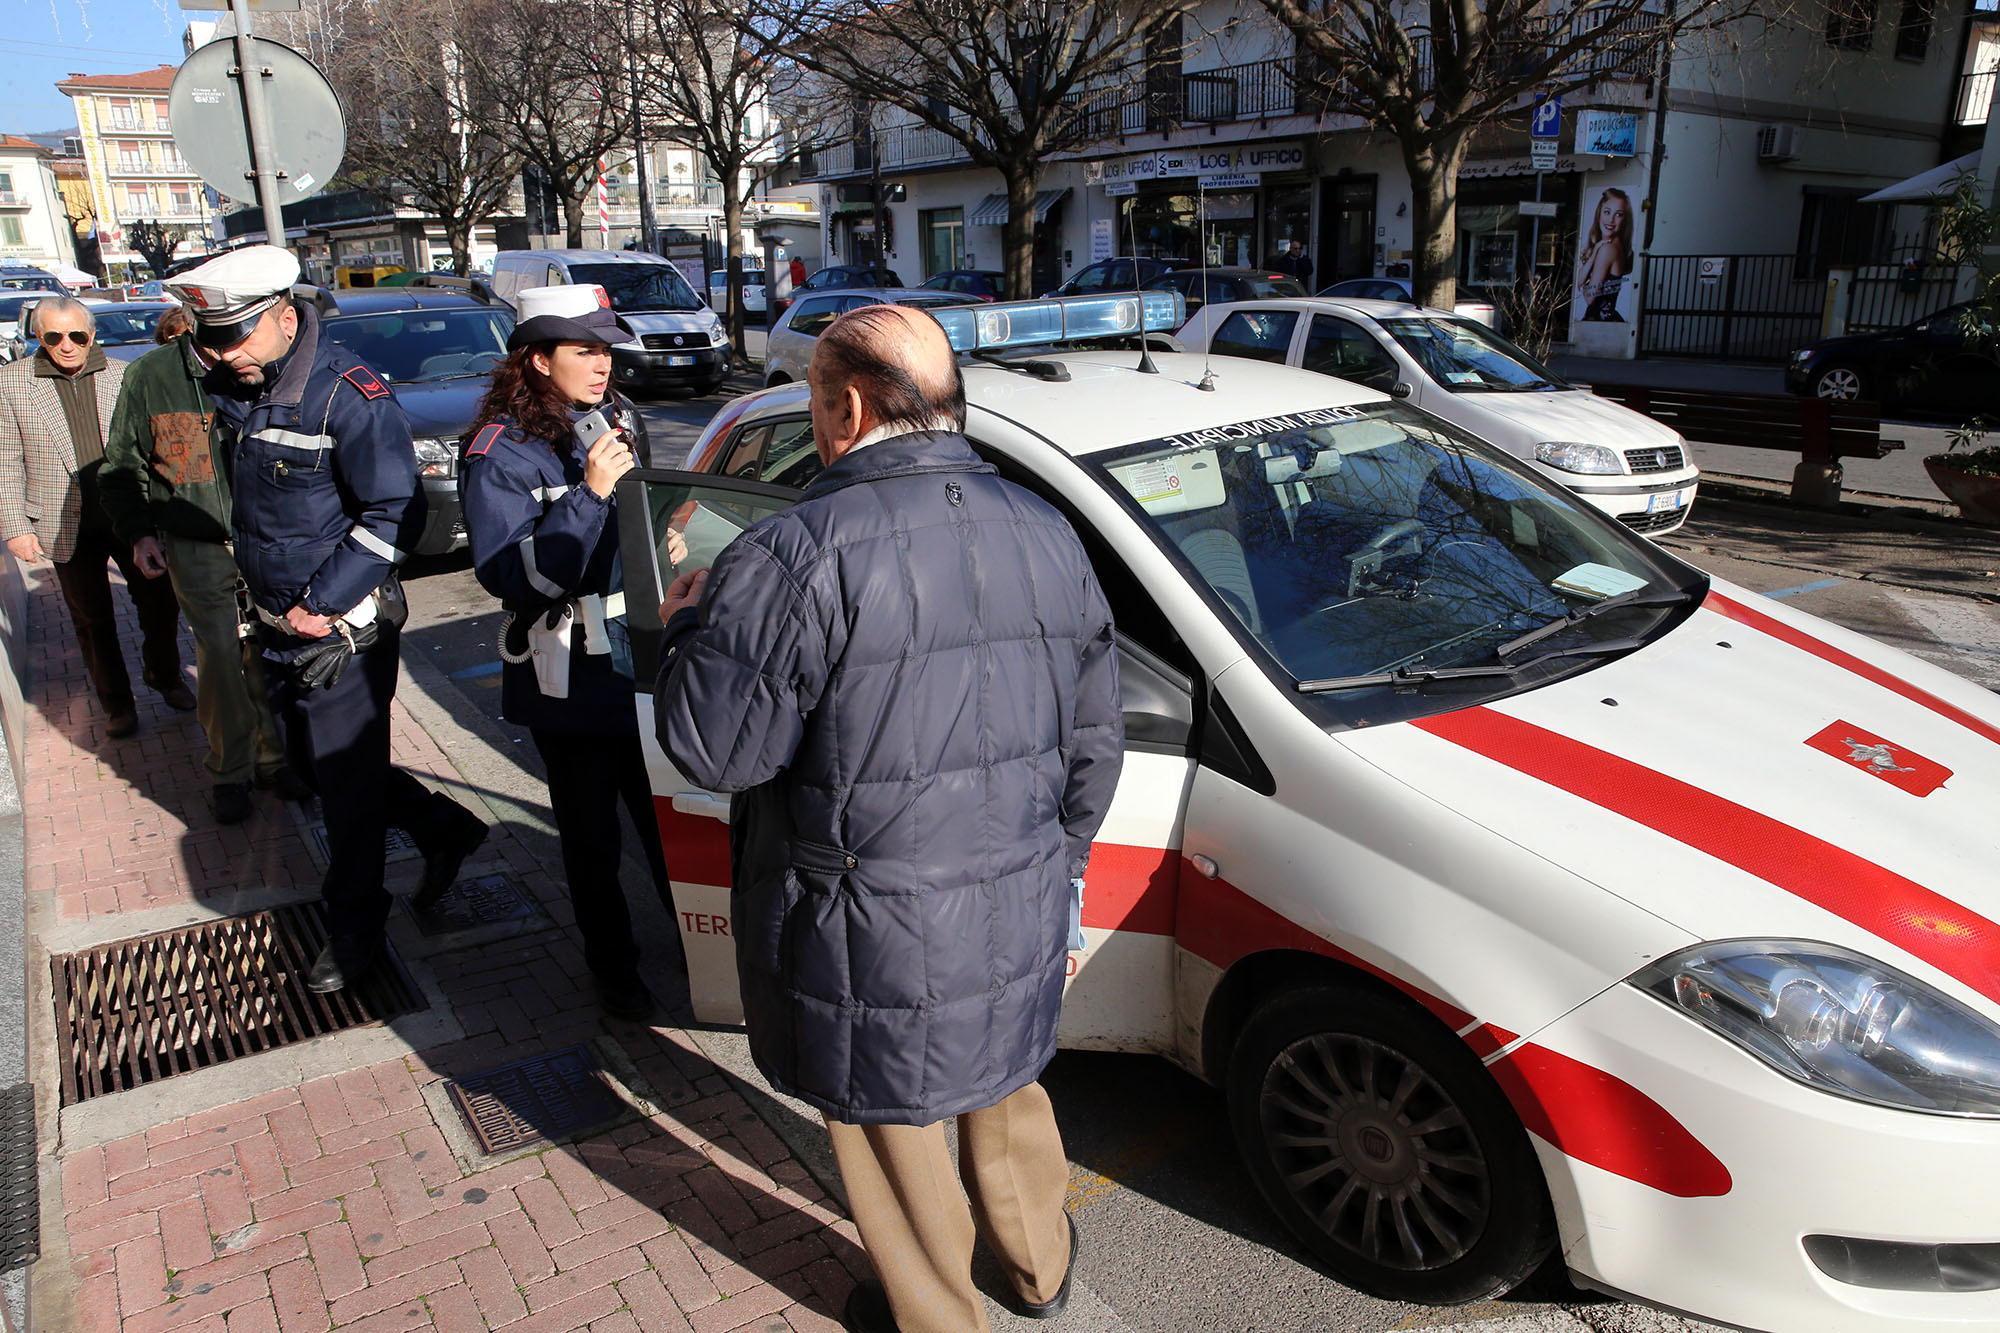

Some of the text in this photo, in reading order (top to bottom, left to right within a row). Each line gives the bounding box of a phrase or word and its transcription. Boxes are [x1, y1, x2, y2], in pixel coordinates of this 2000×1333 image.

[1538, 100, 1556, 132] P
[1250, 148, 1302, 166] UFFICIO
[777, 248, 785, 259] P
[681, 911, 728, 936] TER
